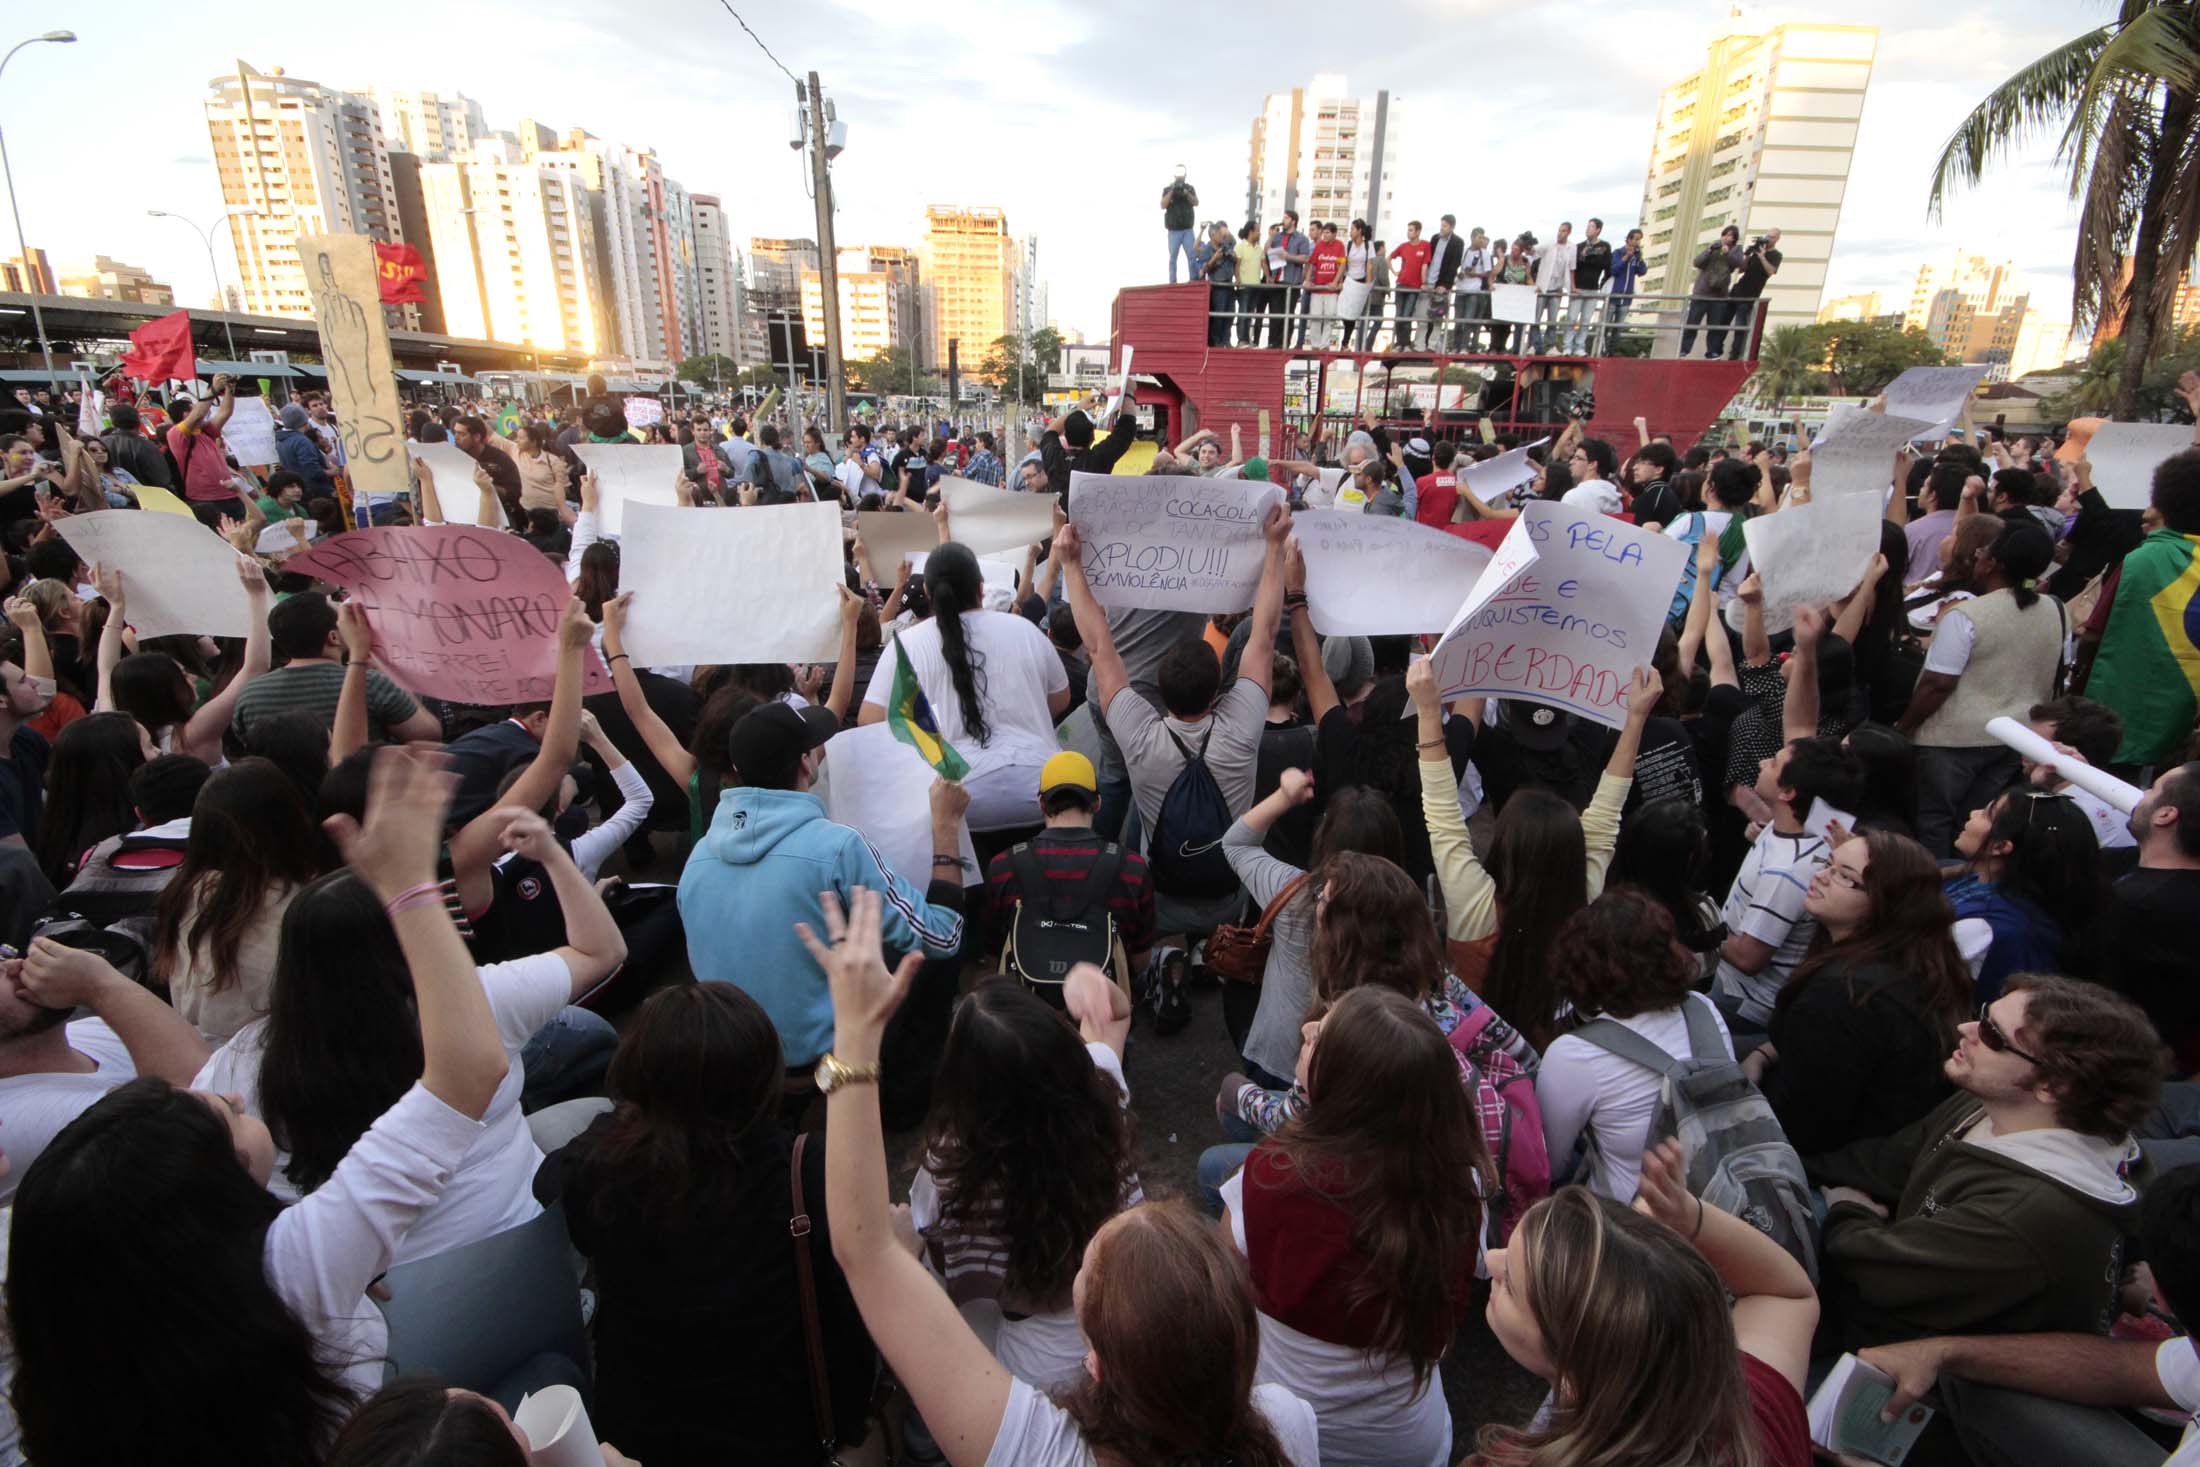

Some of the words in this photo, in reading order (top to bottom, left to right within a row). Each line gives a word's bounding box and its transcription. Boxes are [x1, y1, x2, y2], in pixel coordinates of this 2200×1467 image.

[1566, 521, 1644, 567] PELA
[1557, 580, 1579, 598] E
[1446, 605, 1627, 649] ONQUISTEMOS
[1438, 642, 1632, 711] LIBERDADE
